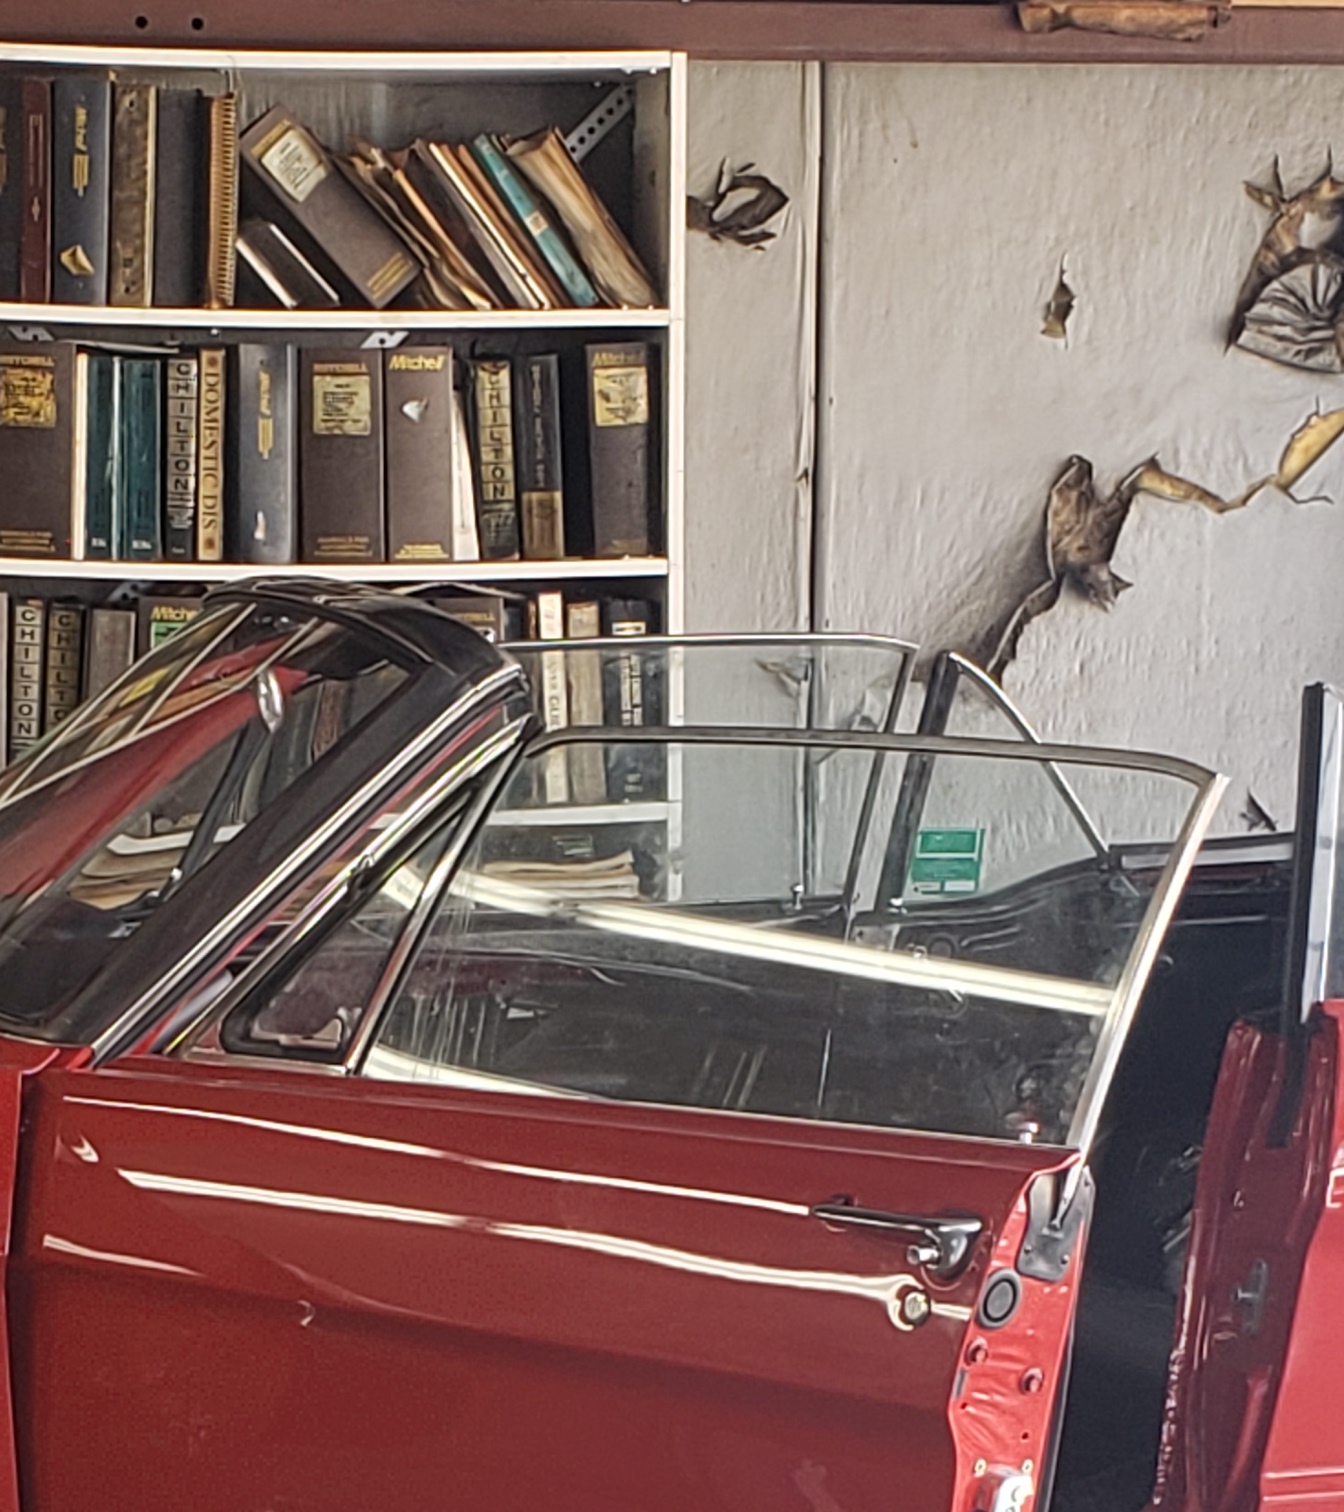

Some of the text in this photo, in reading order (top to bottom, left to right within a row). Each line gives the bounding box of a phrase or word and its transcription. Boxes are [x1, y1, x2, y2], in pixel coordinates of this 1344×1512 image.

[172, 361, 192, 492] CHILTON
[388, 353, 446, 372] Mitchell
[201, 371, 222, 531] DOMESTIC DIS
[16, 608, 38, 737] CHILTON
[53, 613, 73, 723] CHILTO
